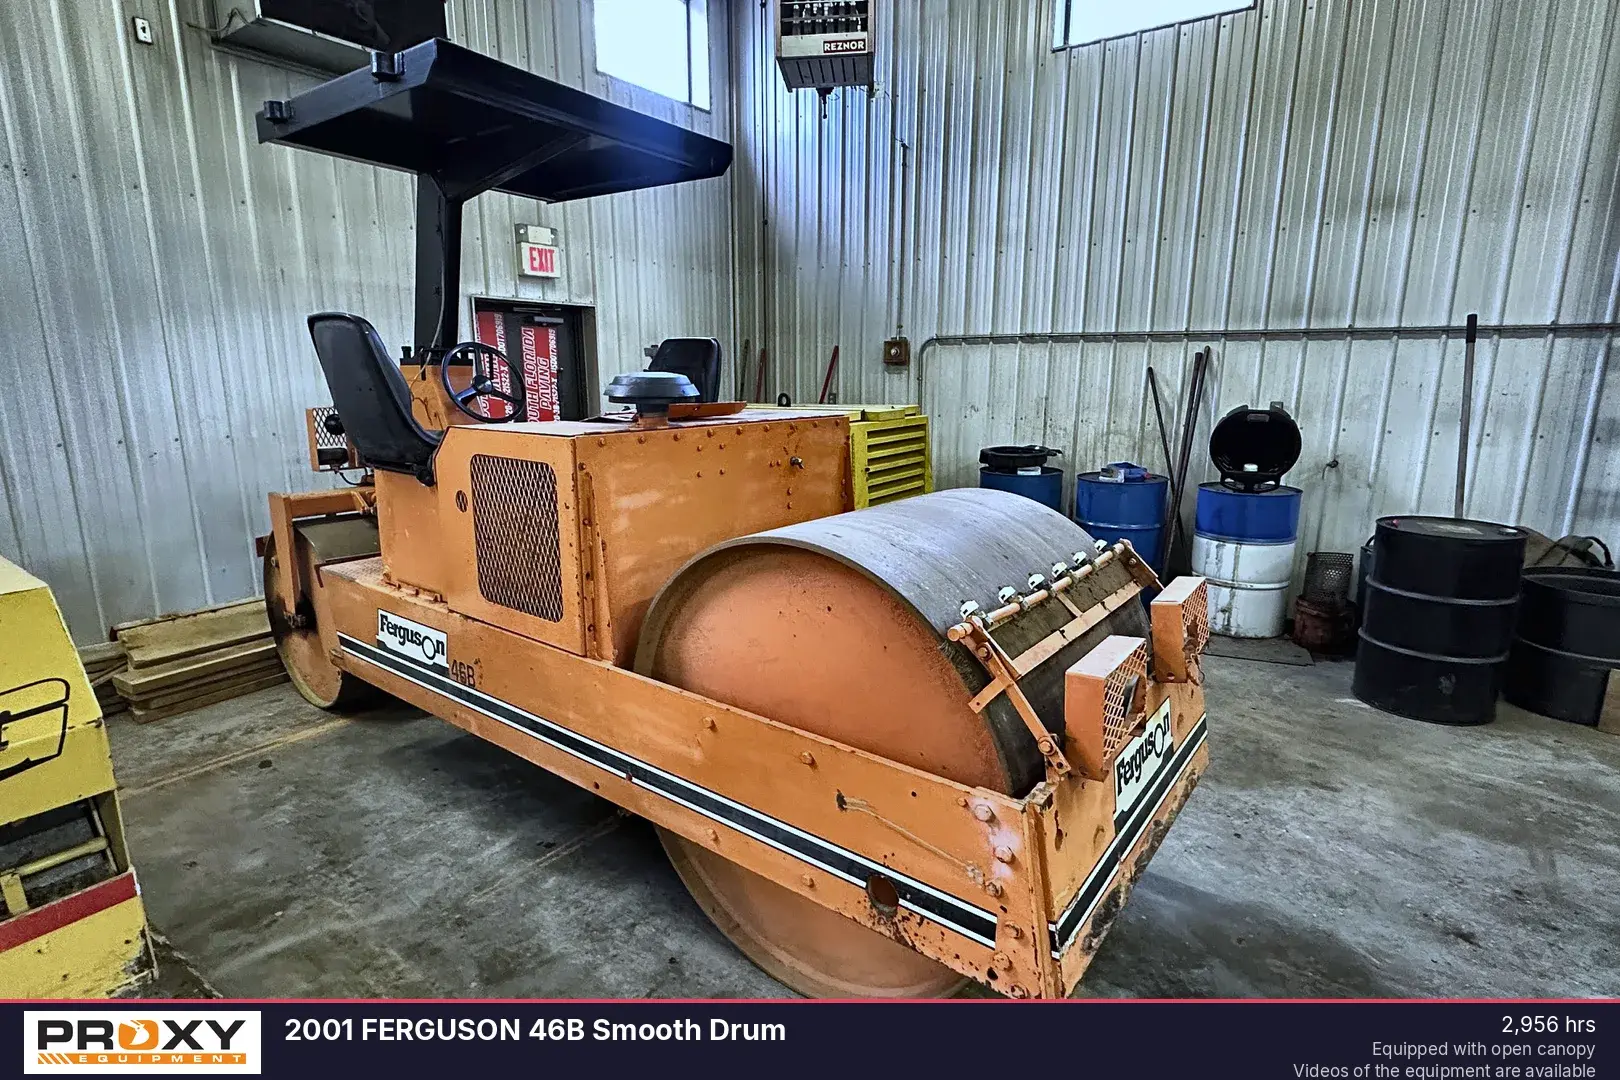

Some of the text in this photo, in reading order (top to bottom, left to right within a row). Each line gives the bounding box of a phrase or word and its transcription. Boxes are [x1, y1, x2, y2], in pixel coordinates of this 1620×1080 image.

[824, 41, 865, 51] REZNOR
[529, 246, 555, 273] EXIT
[494, 313, 507, 356] DOT706919
[522, 327, 539, 422] OUTH FLORIDA
[537, 357, 552, 411] PAVING
[451, 659, 476, 688] 46B
